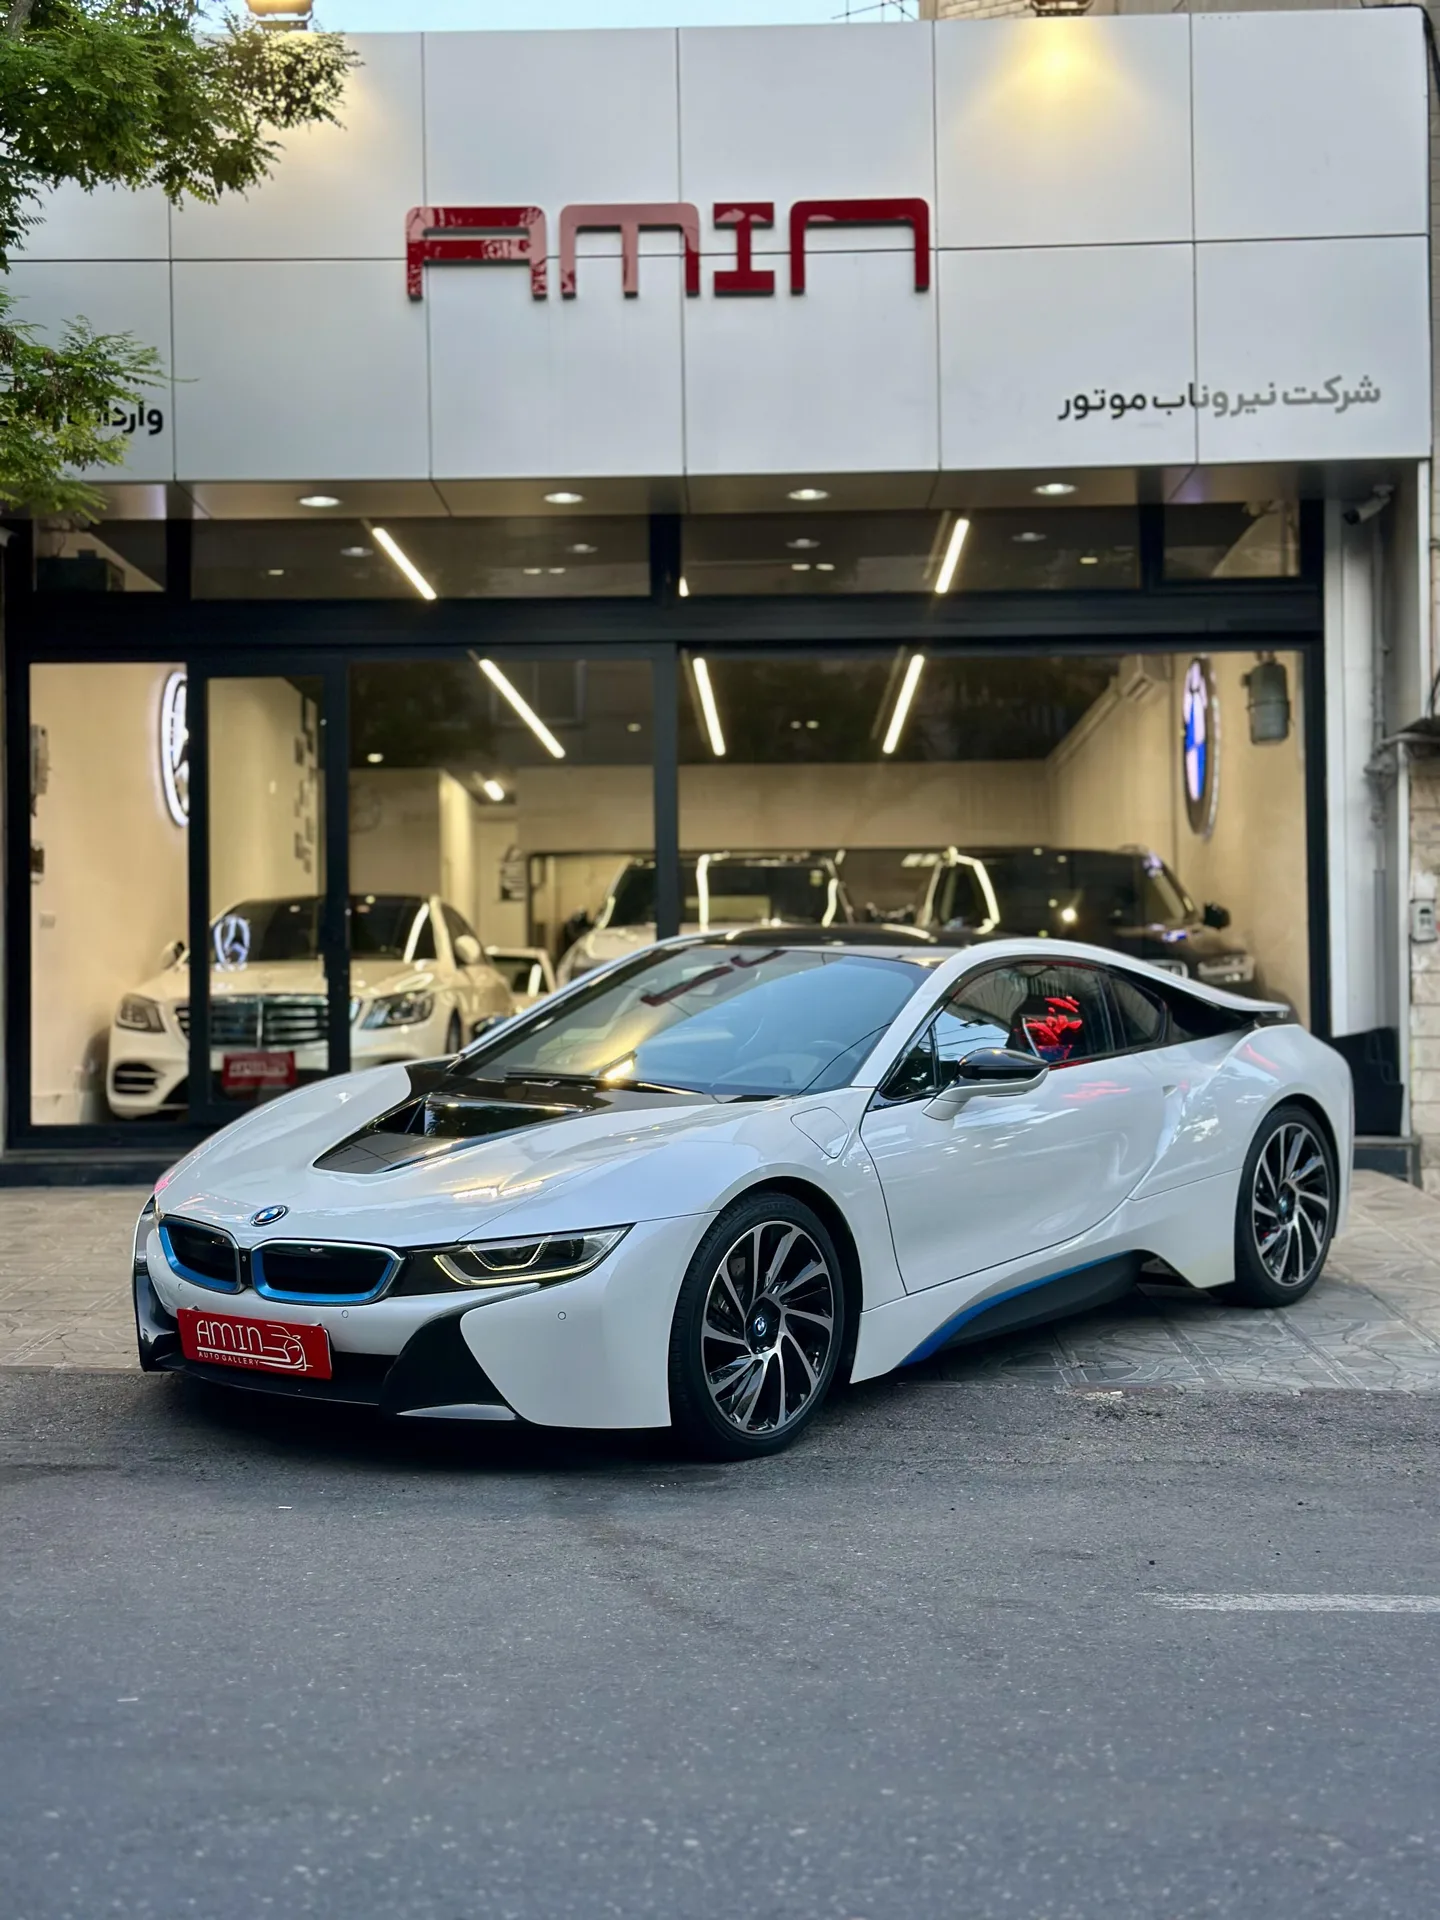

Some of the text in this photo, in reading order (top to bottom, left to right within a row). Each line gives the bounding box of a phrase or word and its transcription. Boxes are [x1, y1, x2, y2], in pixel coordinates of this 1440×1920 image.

[406, 197, 930, 302] AMIN
[1058, 388, 1148, 420] موتور
[1282, 375, 1382, 413] شرکت
[196, 1319, 264, 1353] AMIN
[198, 1351, 260, 1366] AUTO GALLERY
